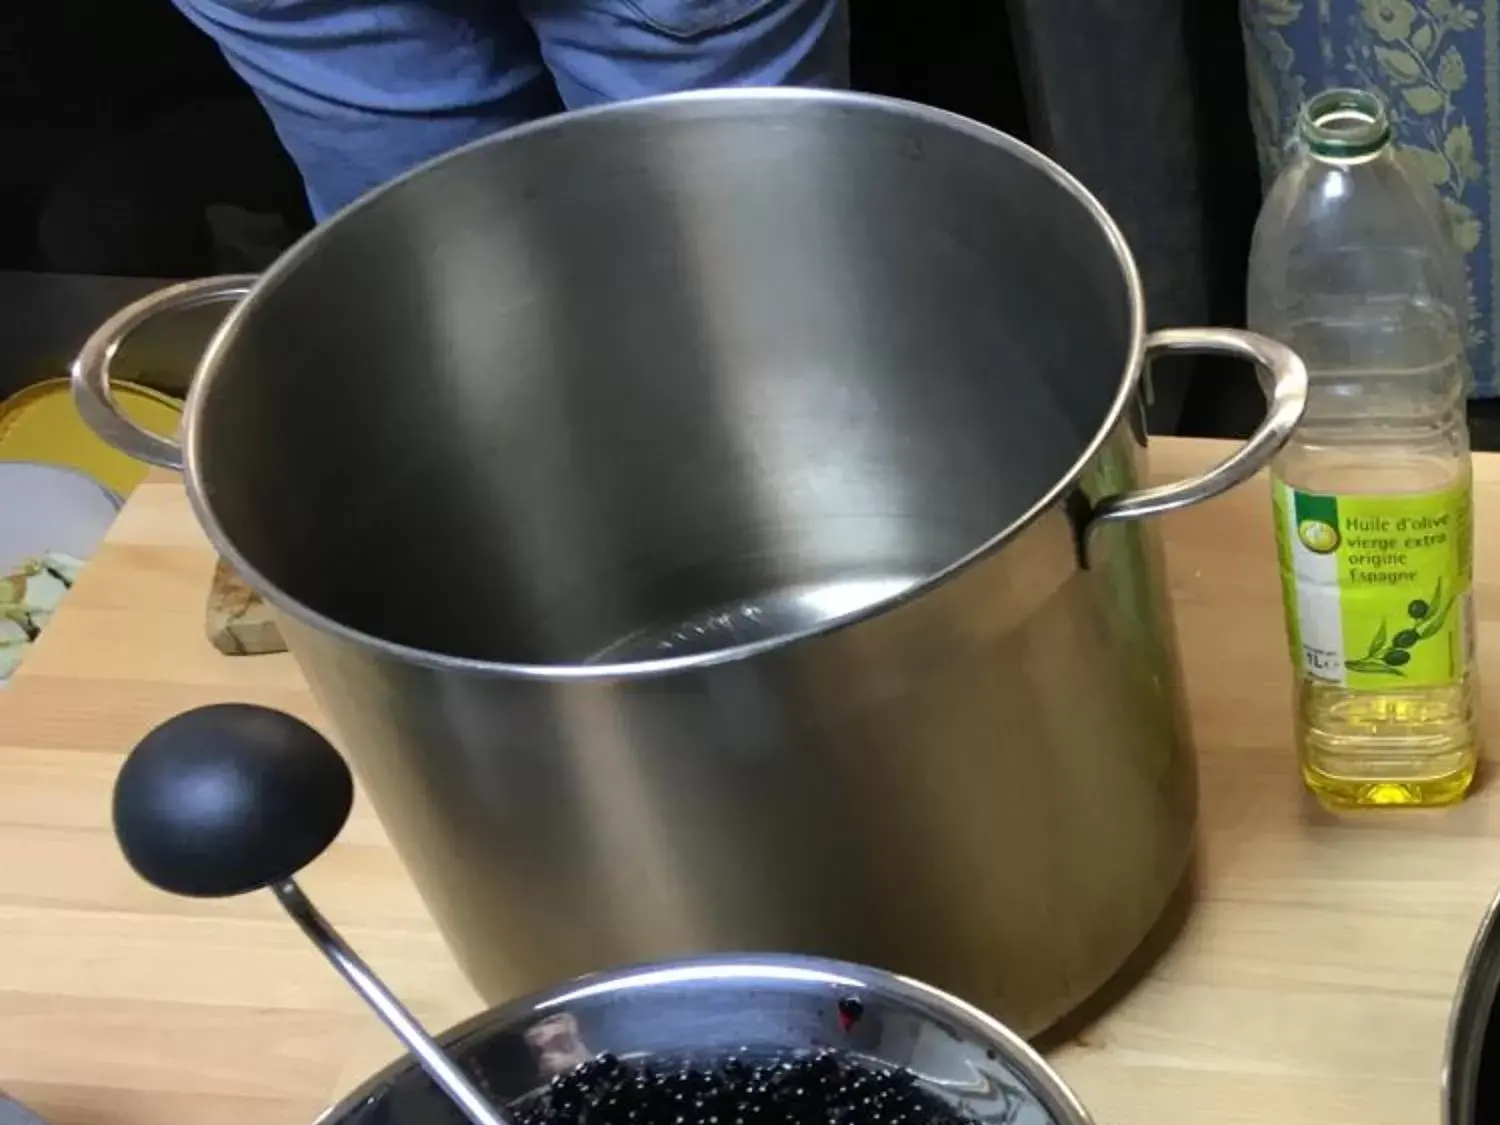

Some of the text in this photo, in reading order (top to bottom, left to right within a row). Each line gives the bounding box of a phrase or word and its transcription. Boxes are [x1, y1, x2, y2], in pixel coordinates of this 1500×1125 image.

[1345, 513, 1450, 532] Huile d'olive
[1346, 533, 1447, 550] vierge extra
[1347, 553, 1408, 568] origine
[1349, 568, 1418, 585] Espagne
